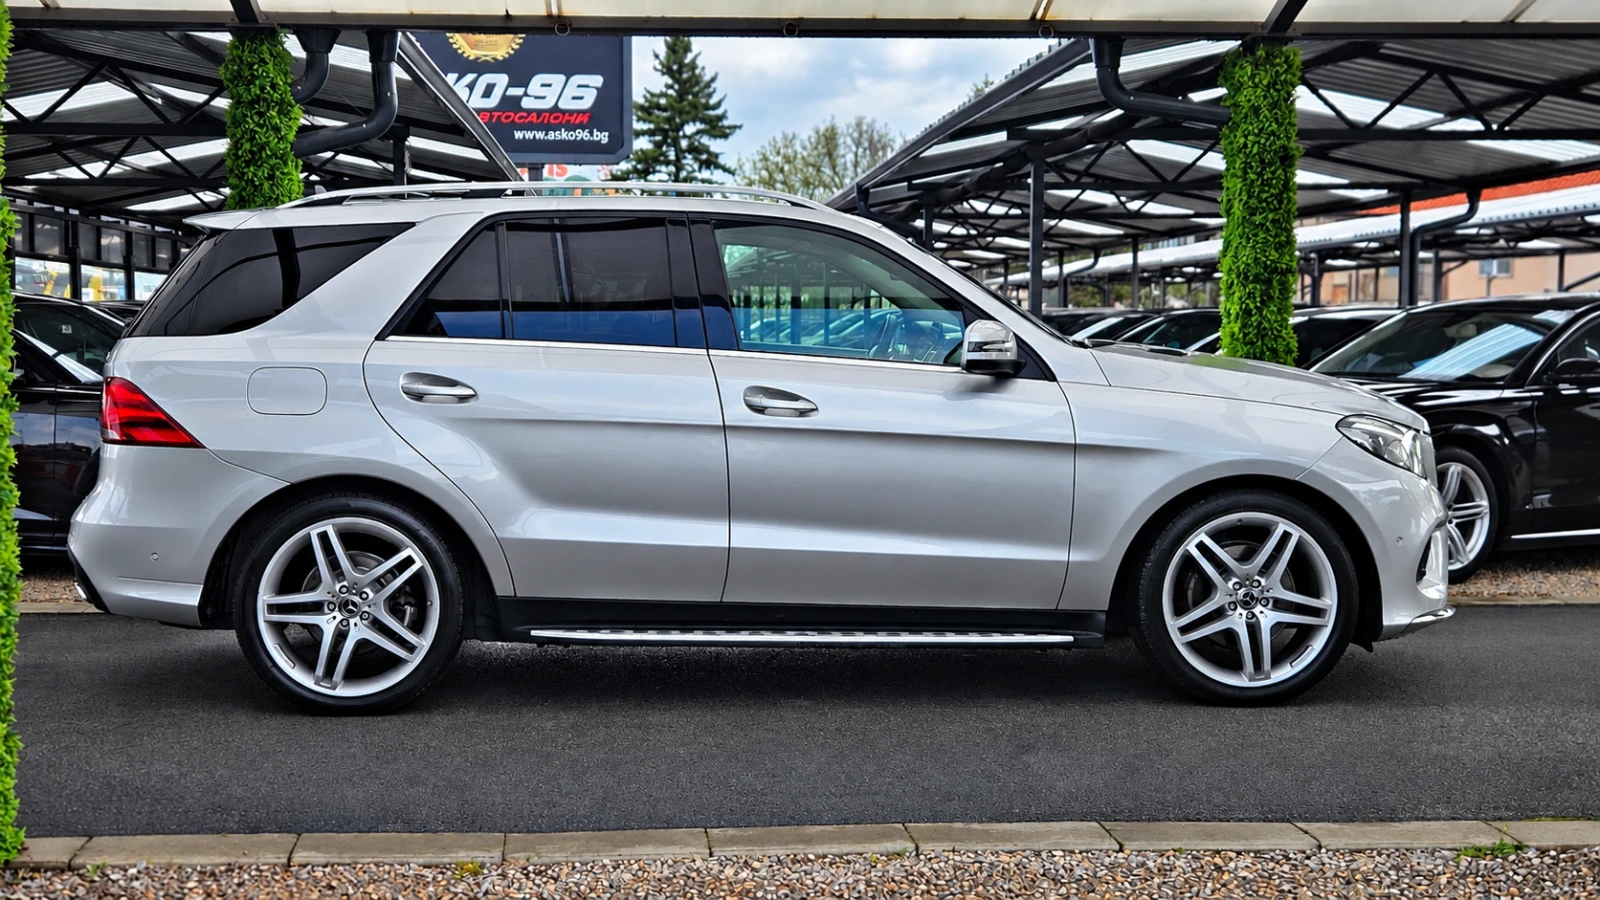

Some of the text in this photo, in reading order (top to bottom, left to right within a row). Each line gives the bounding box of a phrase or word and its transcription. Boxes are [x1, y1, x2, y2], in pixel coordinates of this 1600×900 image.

[446, 73, 604, 109] KO-96
[478, 111, 591, 124] ВТОСАЛОНИ
[514, 128, 609, 143] www.asko96.bg
